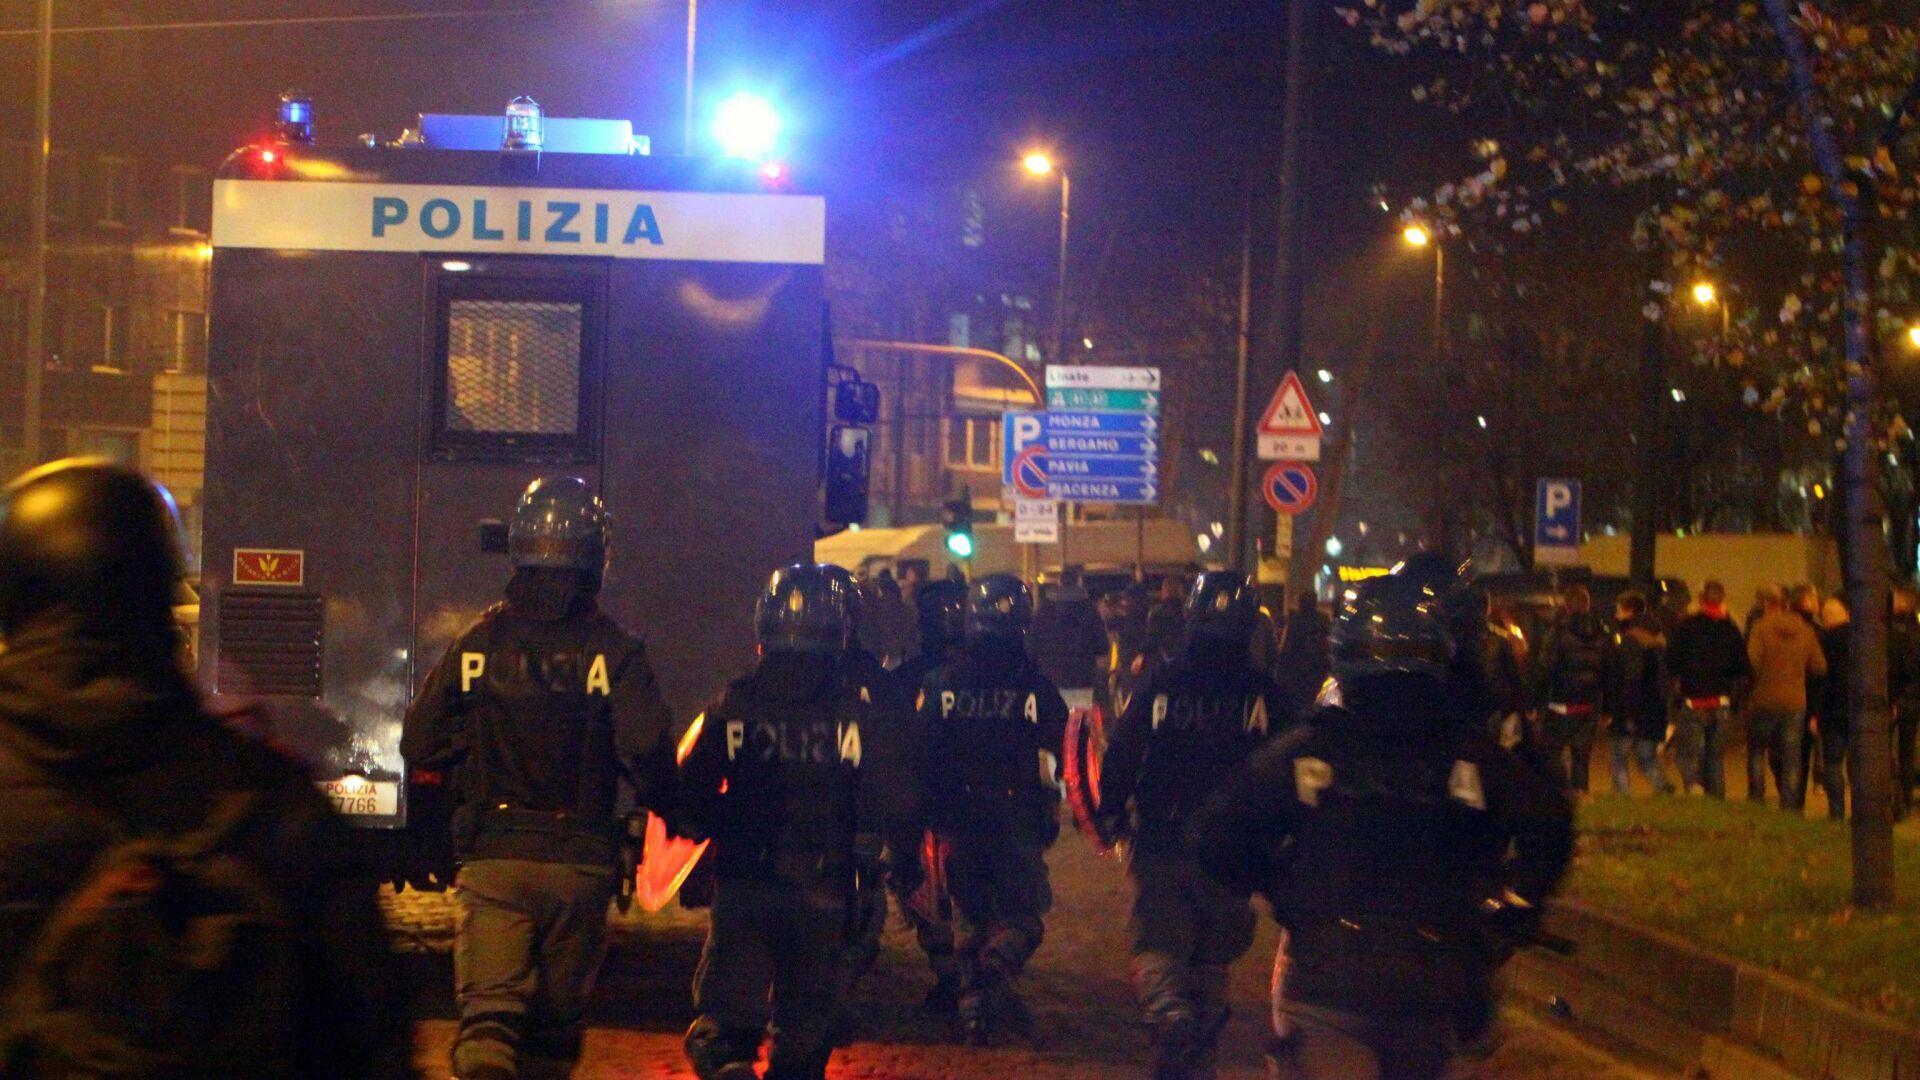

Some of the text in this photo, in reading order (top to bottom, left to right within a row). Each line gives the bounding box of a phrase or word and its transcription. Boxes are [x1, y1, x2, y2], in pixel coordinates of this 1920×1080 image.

[371, 197, 663, 245] POLIZIA
[1049, 415, 1100, 428] MONZA
[1014, 416, 1040, 452] P
[1049, 438, 1119, 451] BERGAMO
[1049, 461, 1088, 472] PAVIA
[1049, 484, 1119, 496] PIACENZA
[1546, 483, 1571, 518] P
[327, 783, 377, 796] POLIZIA
[329, 796, 376, 813] 7766
